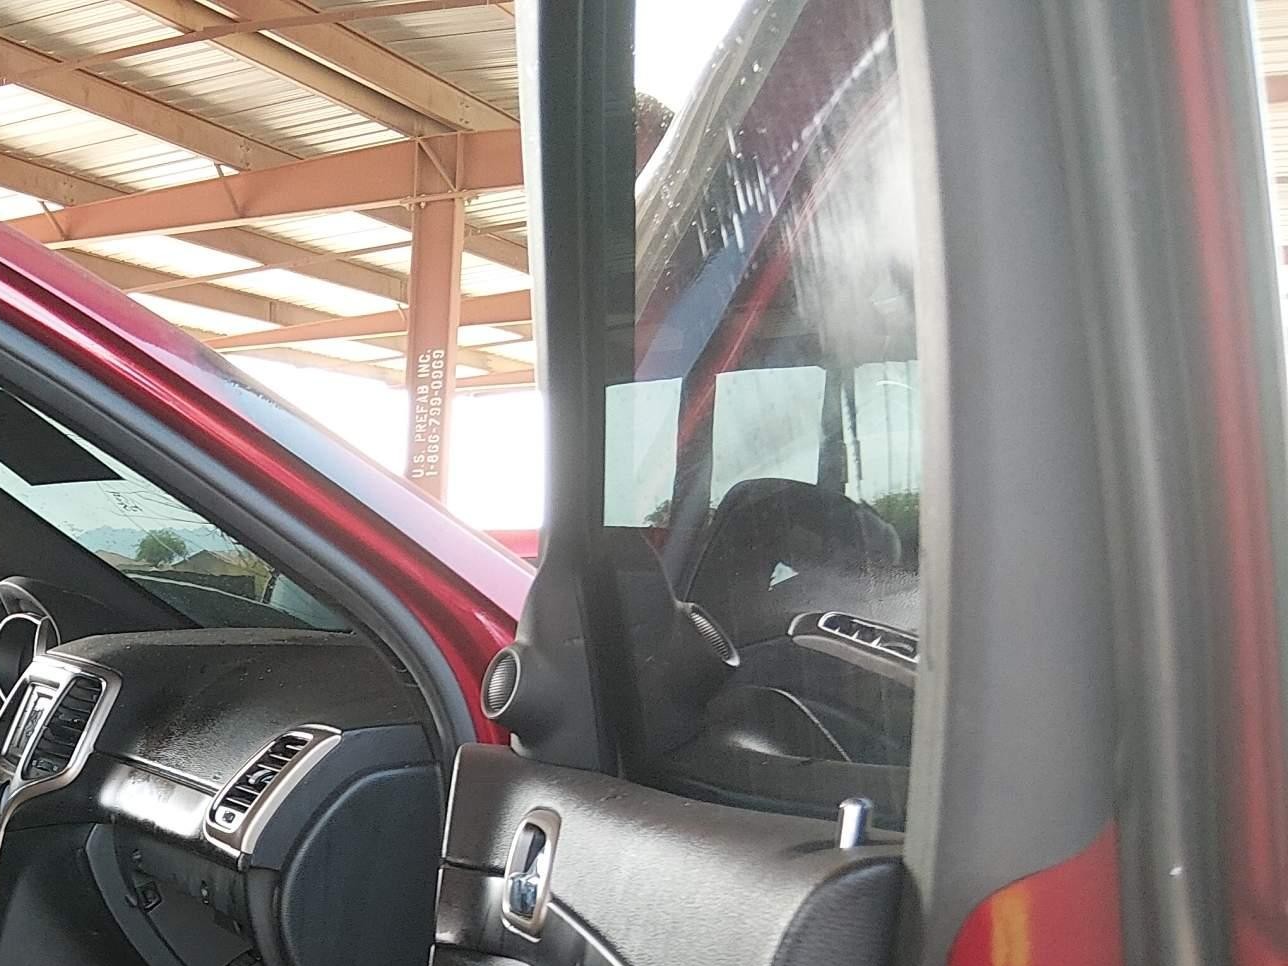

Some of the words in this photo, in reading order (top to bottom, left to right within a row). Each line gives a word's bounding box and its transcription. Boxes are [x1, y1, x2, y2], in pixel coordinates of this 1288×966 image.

[417, 349, 432, 378] INC.
[415, 384, 429, 442] PREFAB
[425, 349, 445, 476] 1-866-799-0969
[411, 450, 425, 478] U.S.
